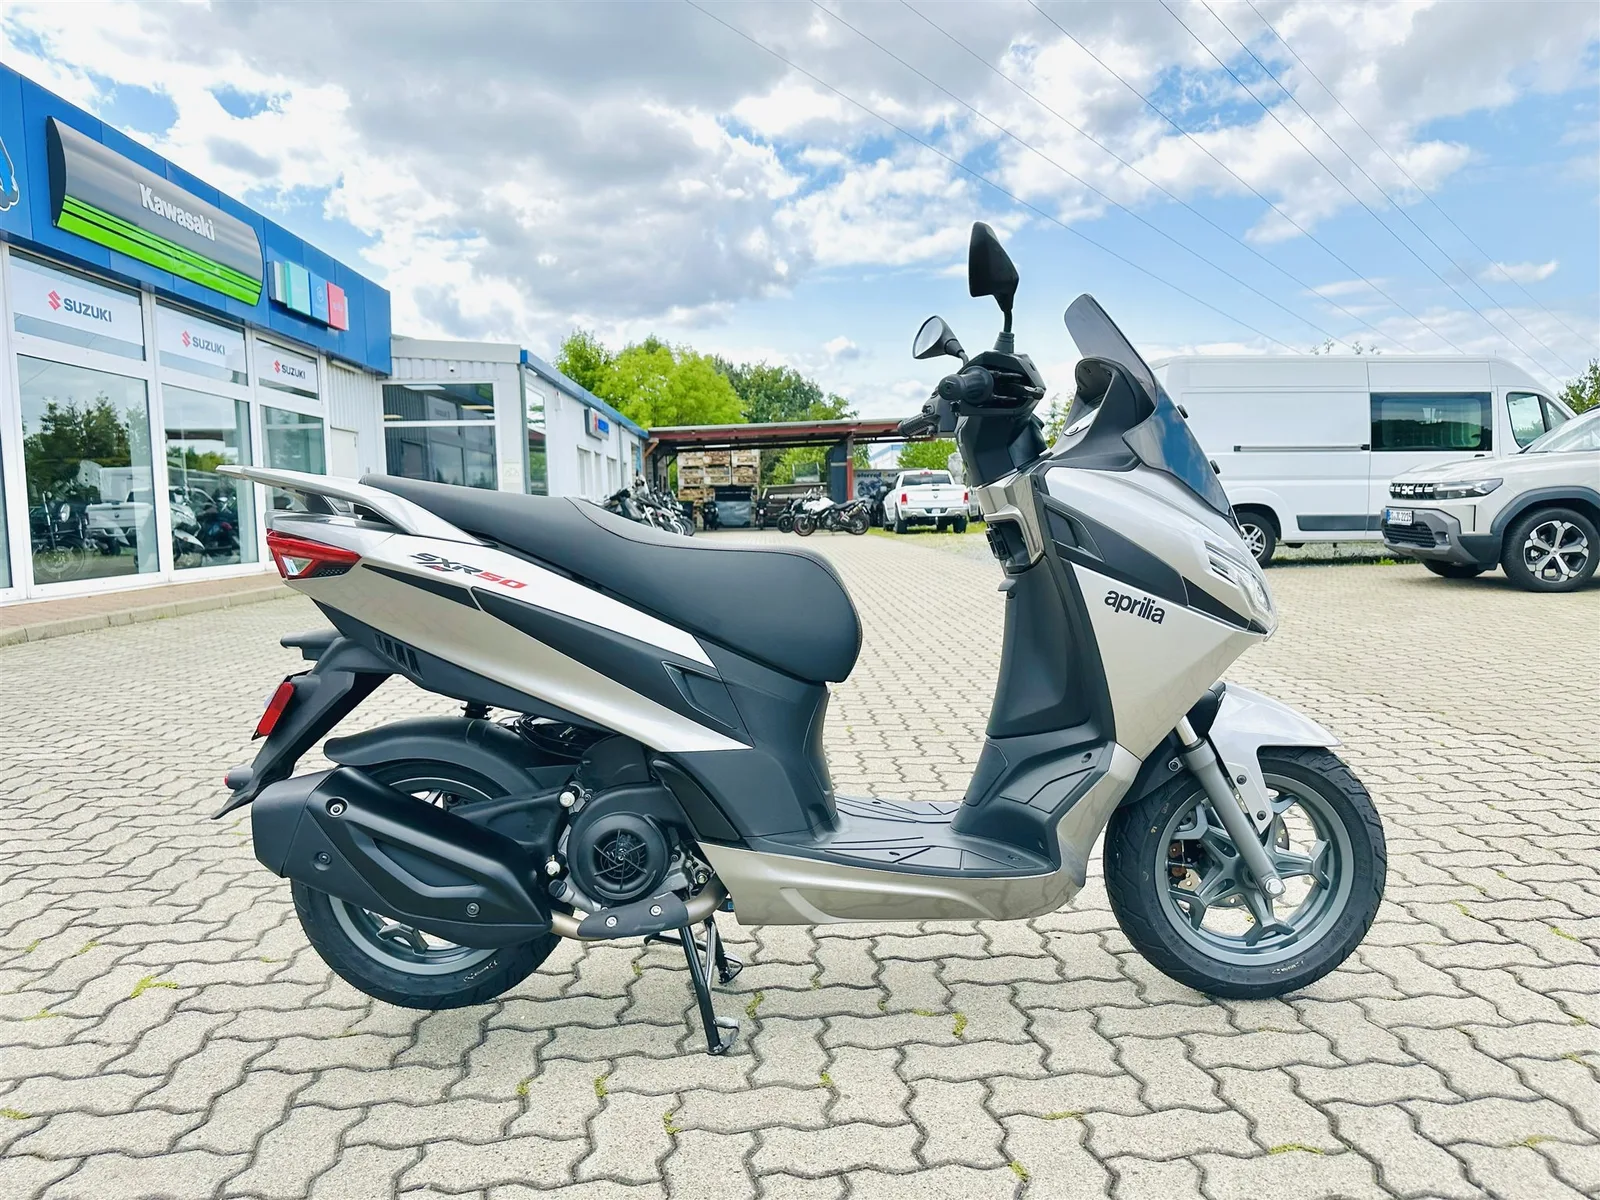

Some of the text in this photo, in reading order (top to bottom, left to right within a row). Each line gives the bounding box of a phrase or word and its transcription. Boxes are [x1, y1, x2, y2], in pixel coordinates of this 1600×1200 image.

[139, 182, 216, 242] Kawasaki
[63, 297, 112, 323] SUZUKI
[192, 336, 226, 356] SUZUKI
[281, 364, 306, 380] SUZUKI
[409, 552, 528, 589] SXR50
[1104, 590, 1166, 625] aprilia
